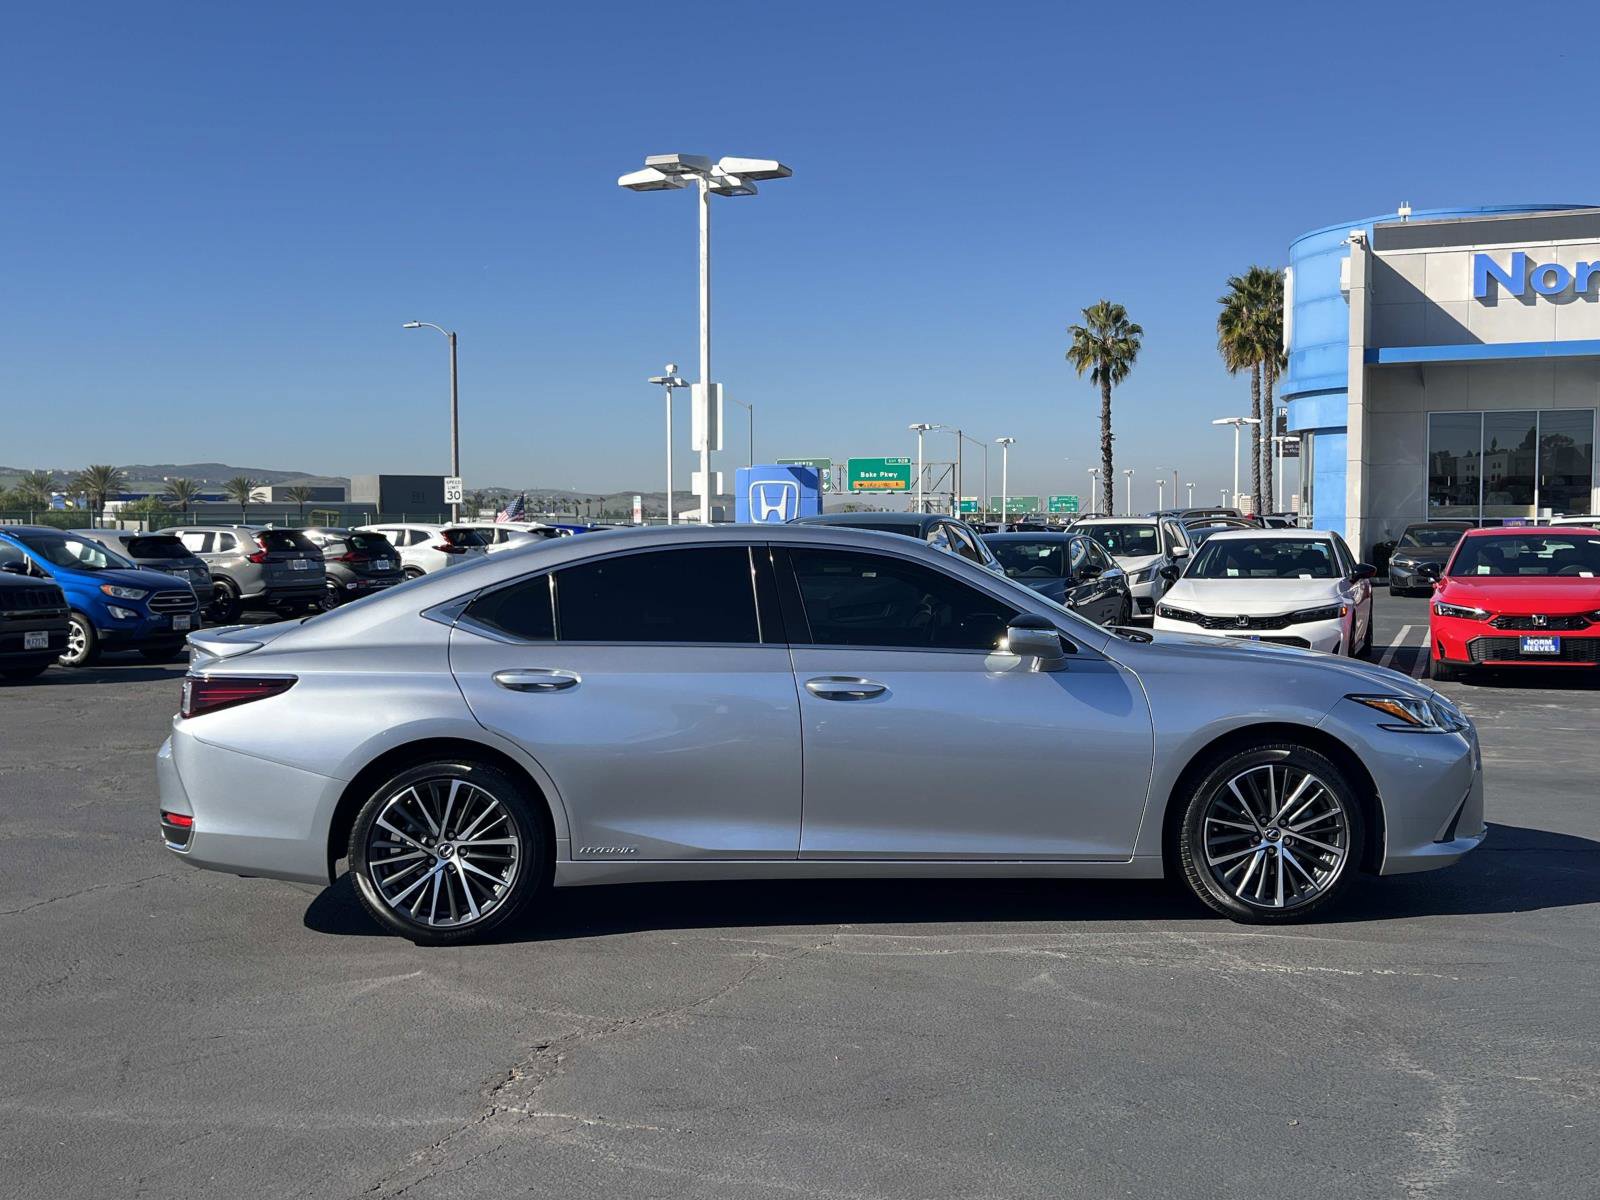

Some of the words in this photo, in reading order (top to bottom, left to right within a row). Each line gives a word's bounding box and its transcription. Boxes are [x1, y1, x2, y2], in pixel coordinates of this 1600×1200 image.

[1473, 251, 1600, 298] Nor
[879, 471, 898, 479] Pkwy
[447, 490, 461, 500] 30
